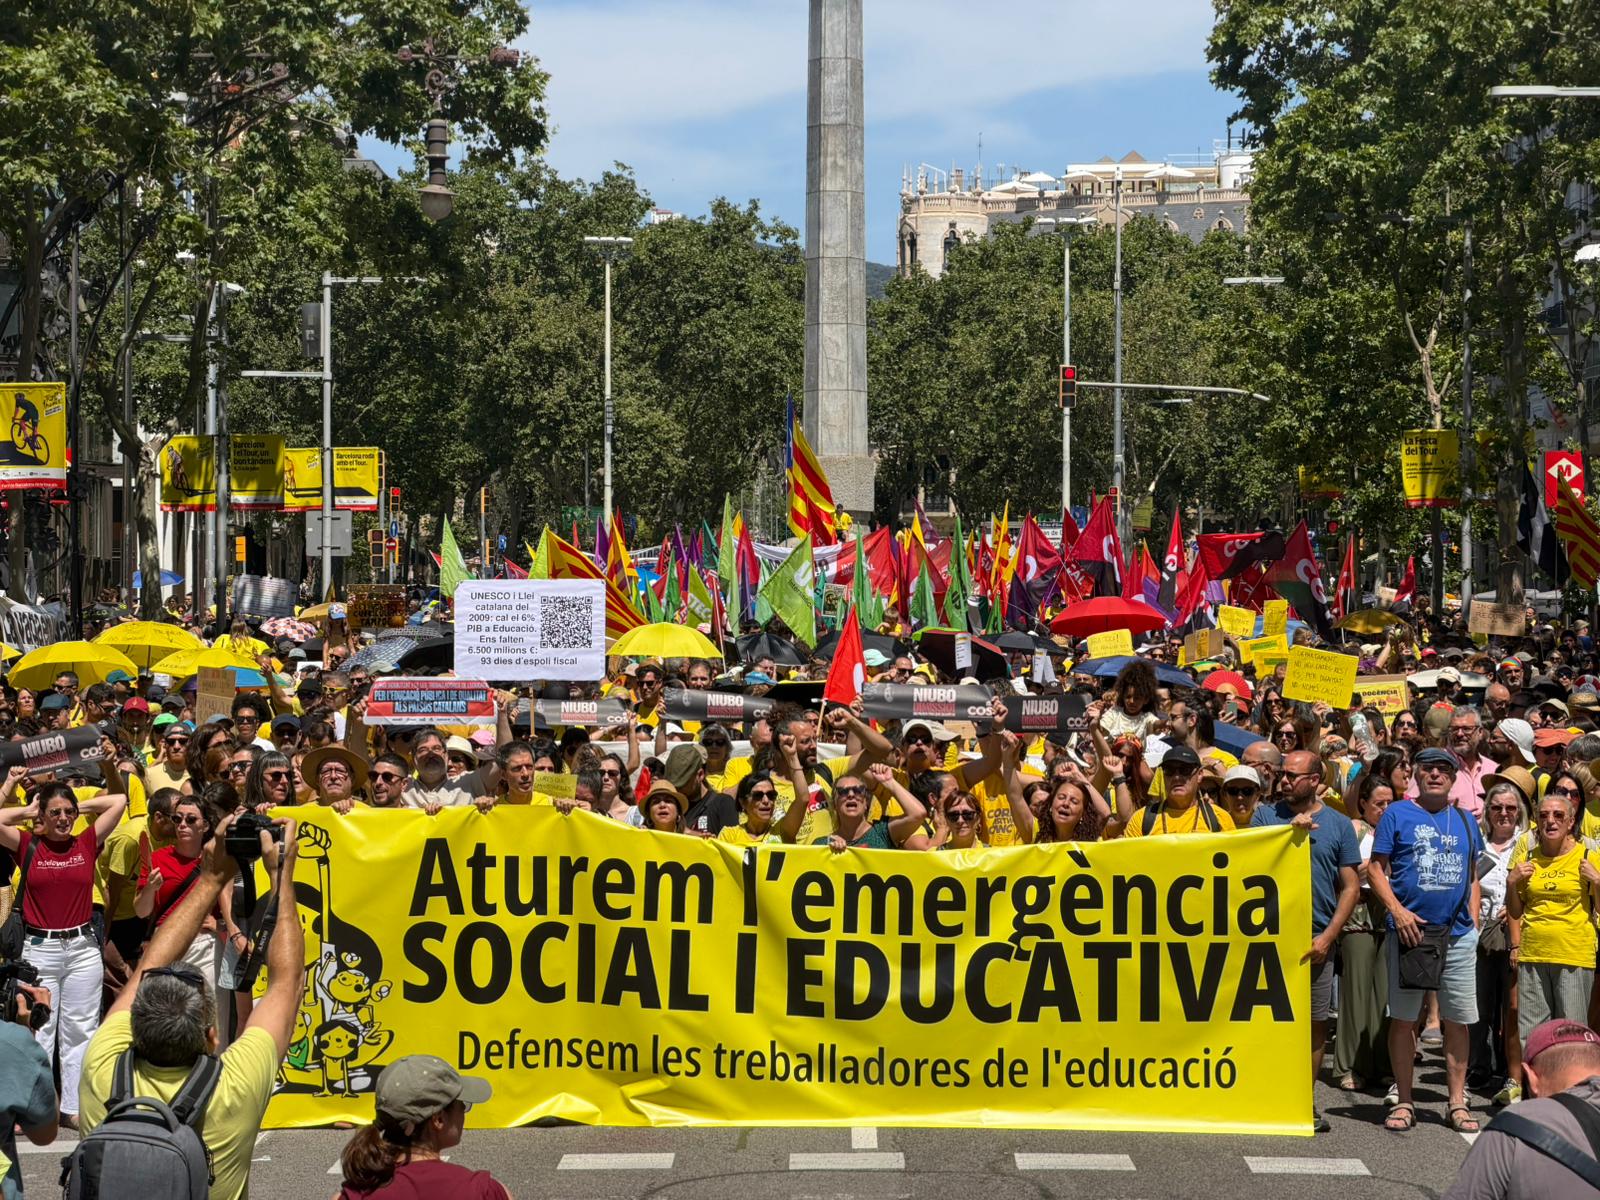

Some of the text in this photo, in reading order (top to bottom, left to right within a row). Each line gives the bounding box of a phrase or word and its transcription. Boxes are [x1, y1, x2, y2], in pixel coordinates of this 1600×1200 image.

[233, 441, 266, 449] Barcelona
[1405, 437, 1438, 446] La Festa
[1405, 447, 1438, 456] del Tour
[1558, 465, 1572, 477] M
[1224, 538, 1261, 558] CG
[470, 592, 535, 600] UNESCO i Llei
[495, 614, 509, 622] cal
[511, 614, 520, 622] el
[521, 614, 536, 622] 6%
[466, 625, 482, 633] PIB
[492, 624, 537, 633] Educació.
[479, 635, 524, 643] Ens falten
[467, 646, 538, 655] 6.500 milions €:
[480, 656, 578, 667] 93 dies d'espoli fiscal
[374, 690, 386, 701] PER
[432, 700, 467, 713] CATALANS
[1540, 870, 1566, 879] SOS
[409, 837, 1279, 962] Aturem l'emergència
[403, 921, 1294, 1024] SOCIAL I EDUCATIVA
[459, 1028, 1237, 1089] Defensem les treballadores de l'educació
